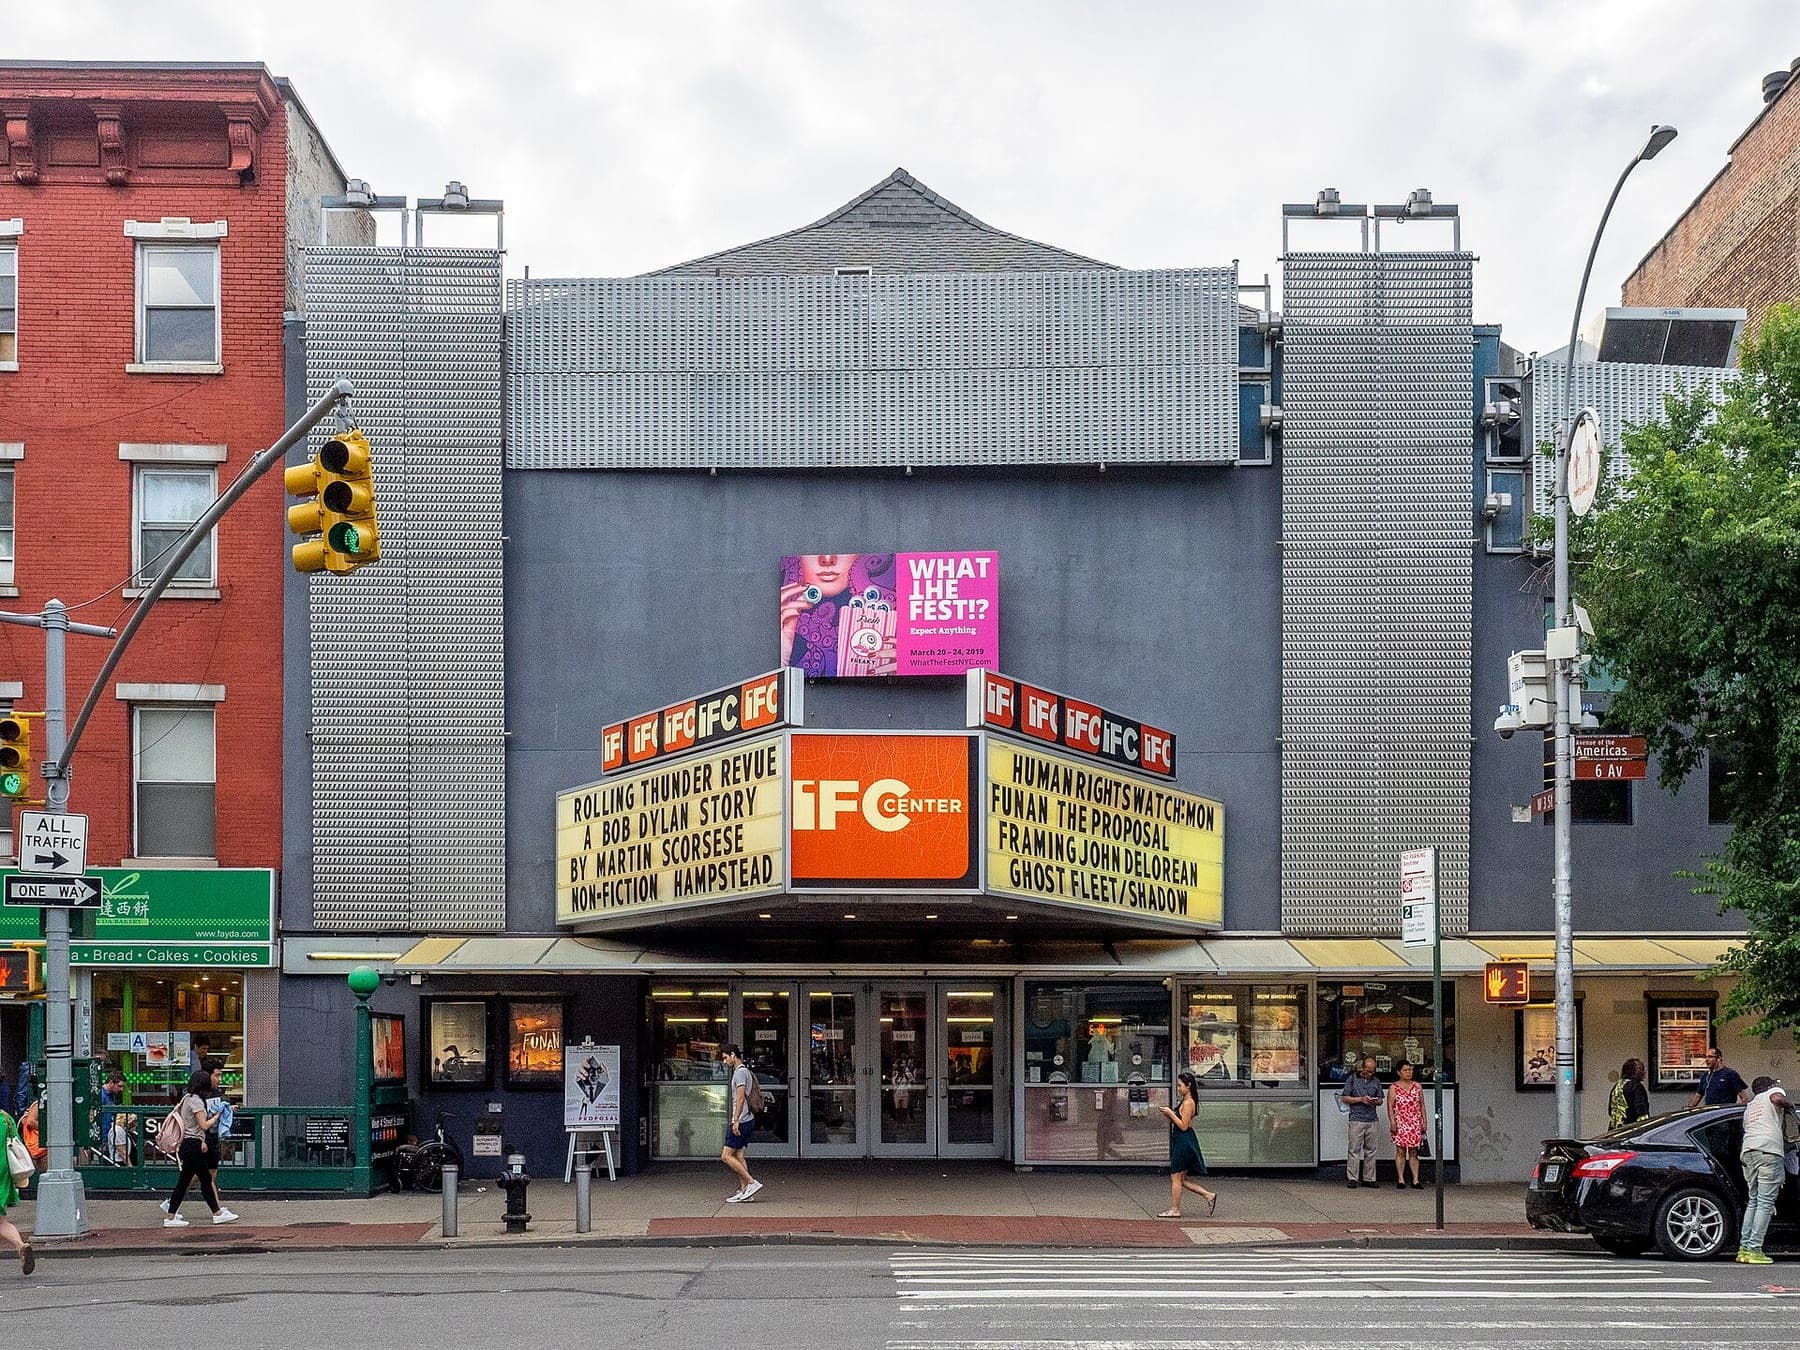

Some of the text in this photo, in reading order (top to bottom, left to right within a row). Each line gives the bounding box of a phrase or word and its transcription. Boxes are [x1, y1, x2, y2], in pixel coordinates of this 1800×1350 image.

[908, 557, 991, 580] WHAT
[908, 579, 959, 601] THE
[909, 599, 990, 621] FEST!?
[856, 615, 881, 625] Fresh
[910, 626, 977, 636] Expect Anything
[850, 657, 876, 665] FREAKY
[1576, 745, 1628, 756] Americas
[1595, 764, 1623, 777] 6 Av
[574, 746, 777, 823] ROLLING THUNDER REVUE
[1013, 753, 1072, 796] HUMAN
[1076, 776, 1131, 811] RIGHTS
[883, 798, 962, 814] CENTER
[37, 818, 71, 833] ALL
[583, 786, 758, 850] A BOB DYLAN STORY
[992, 783, 1170, 851] FUNAN THE PROPOSAL
[25, 835, 81, 849] TRAFFIC
[570, 824, 744, 883] BY MARTIN SCORSESE
[999, 820, 1198, 887] FRAMING JOHN DELOREAN
[19, 885, 87, 897] ONE WAY
[571, 854, 773, 912] NON-FICTION HAMPSTEAD
[1010, 858, 1188, 916] GHOST FLEET/SHADOW
[1404, 907, 1411, 918] 2
[195, 930, 259, 940] www.fayda.com
[93, 949, 133, 961] Bread
[147, 949, 190, 961] Cakes
[203, 950, 258, 962] Cookies
[1516, 970, 1526, 994] 3
[133, 1035, 144, 1047] A
[523, 1032, 560, 1051] FUNAN
